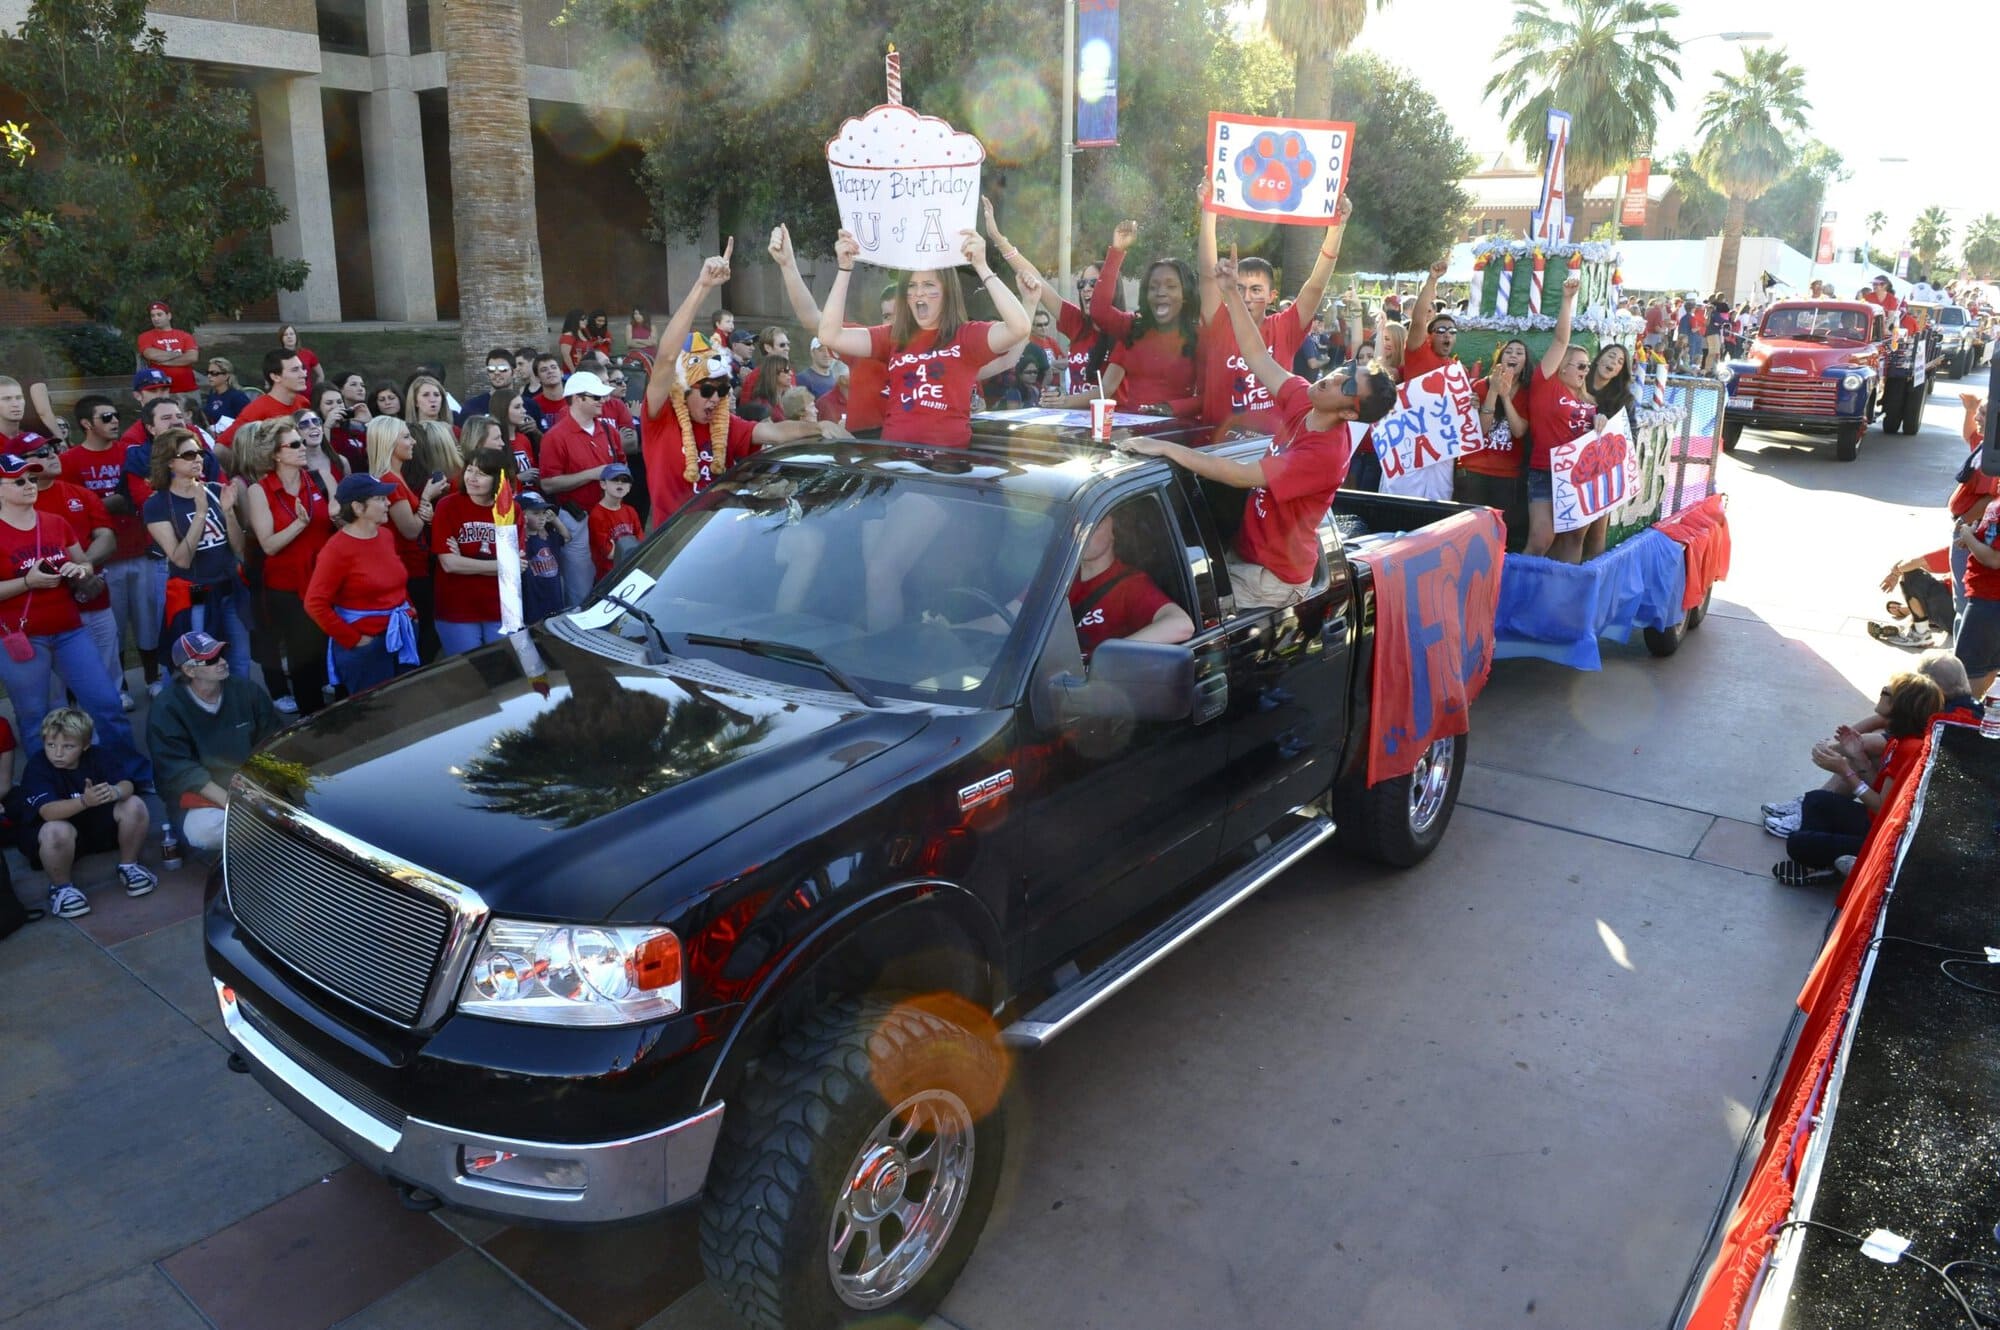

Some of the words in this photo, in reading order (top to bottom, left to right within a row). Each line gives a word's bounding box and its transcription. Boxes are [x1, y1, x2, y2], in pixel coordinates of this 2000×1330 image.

[1215, 124, 1231, 203] BEAR
[1323, 133, 1343, 214] DOWN
[835, 169, 881, 202] Happy
[889, 166, 974, 206] Birthday
[851, 211, 881, 252] U
[915, 208, 950, 253] A
[915, 363, 928, 383] 4
[1244, 373, 1256, 388] 4
[900, 383, 944, 404] LIFE
[1231, 386, 1270, 407] LIFE
[700, 464, 712, 481] 4
[457, 526, 496, 544] ARIZO
